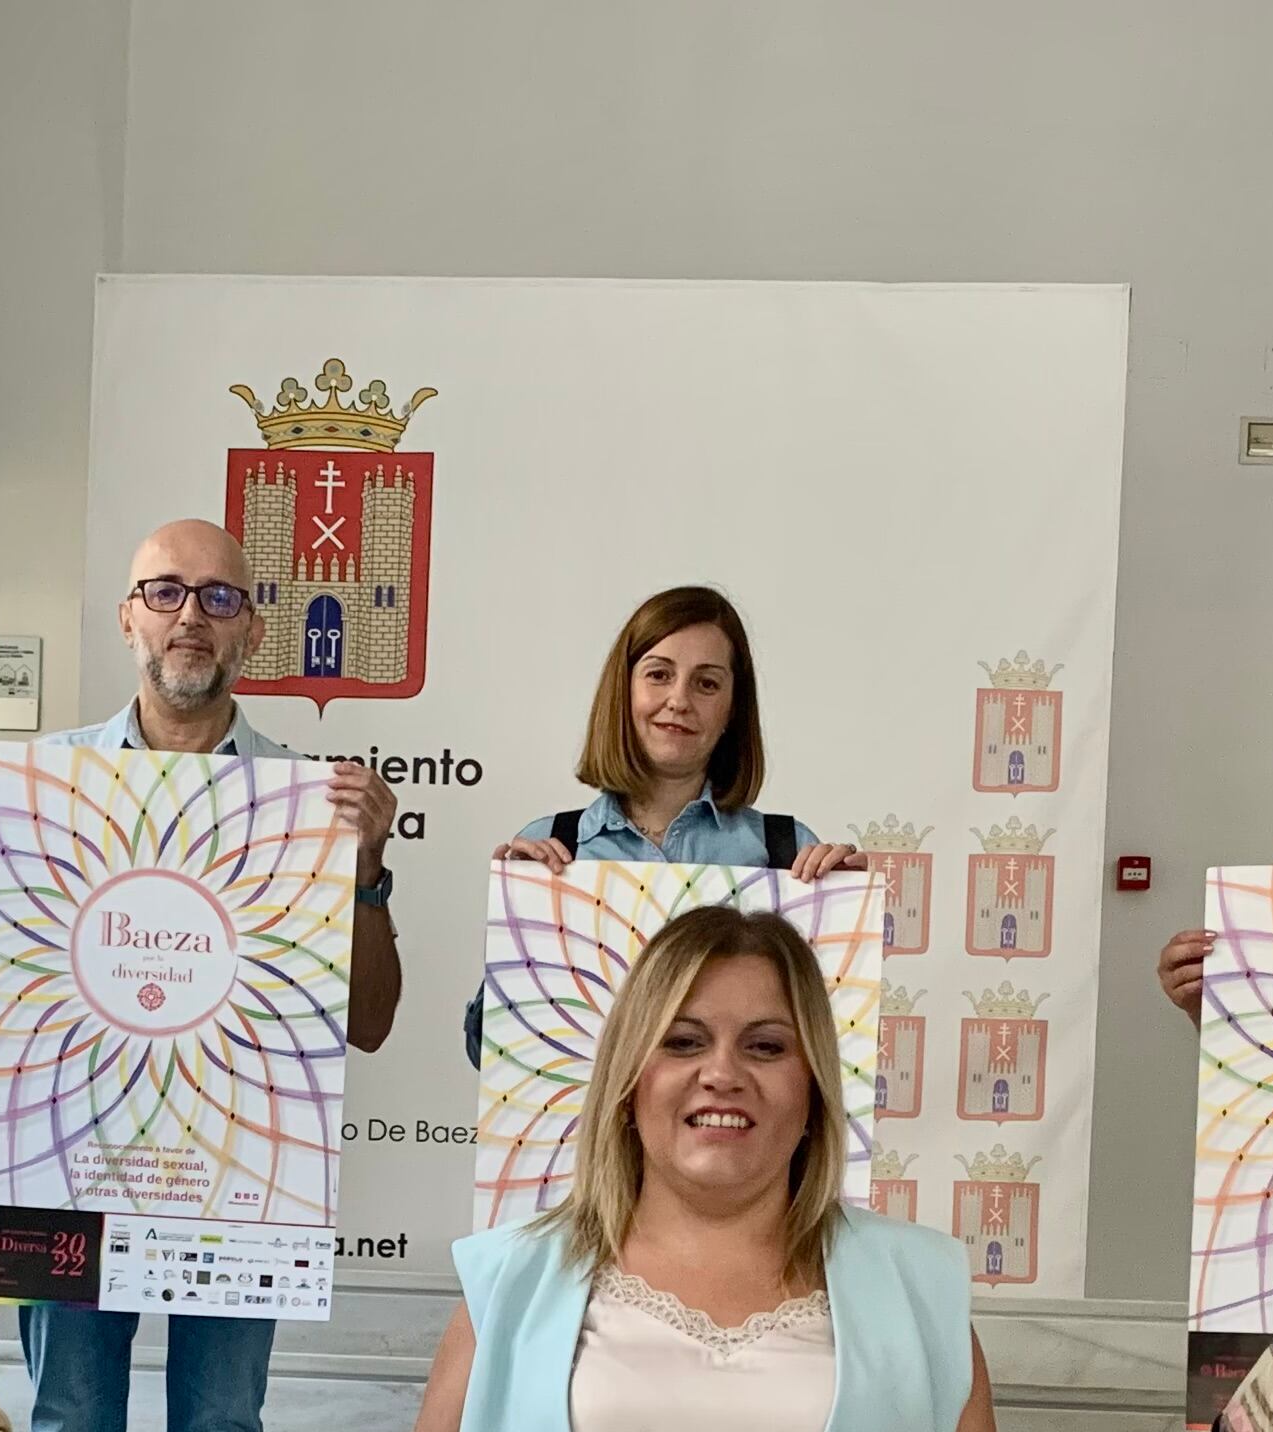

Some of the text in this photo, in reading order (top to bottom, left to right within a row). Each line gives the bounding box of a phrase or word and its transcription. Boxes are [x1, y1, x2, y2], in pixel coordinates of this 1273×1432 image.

[96, 910, 213, 954] Baeza
[111, 963, 193, 984] diversidad
[368, 1119, 406, 1142] De
[162, 1146, 184, 1154] favor
[185, 1147, 196, 1155] de
[73, 1153, 208, 1173] La diversidad sexual,
[70, 1168, 210, 1188] la identidad de género
[75, 1187, 204, 1203] y otras diversidades
[51, 1231, 86, 1255] 20
[50, 1250, 86, 1276] 22
